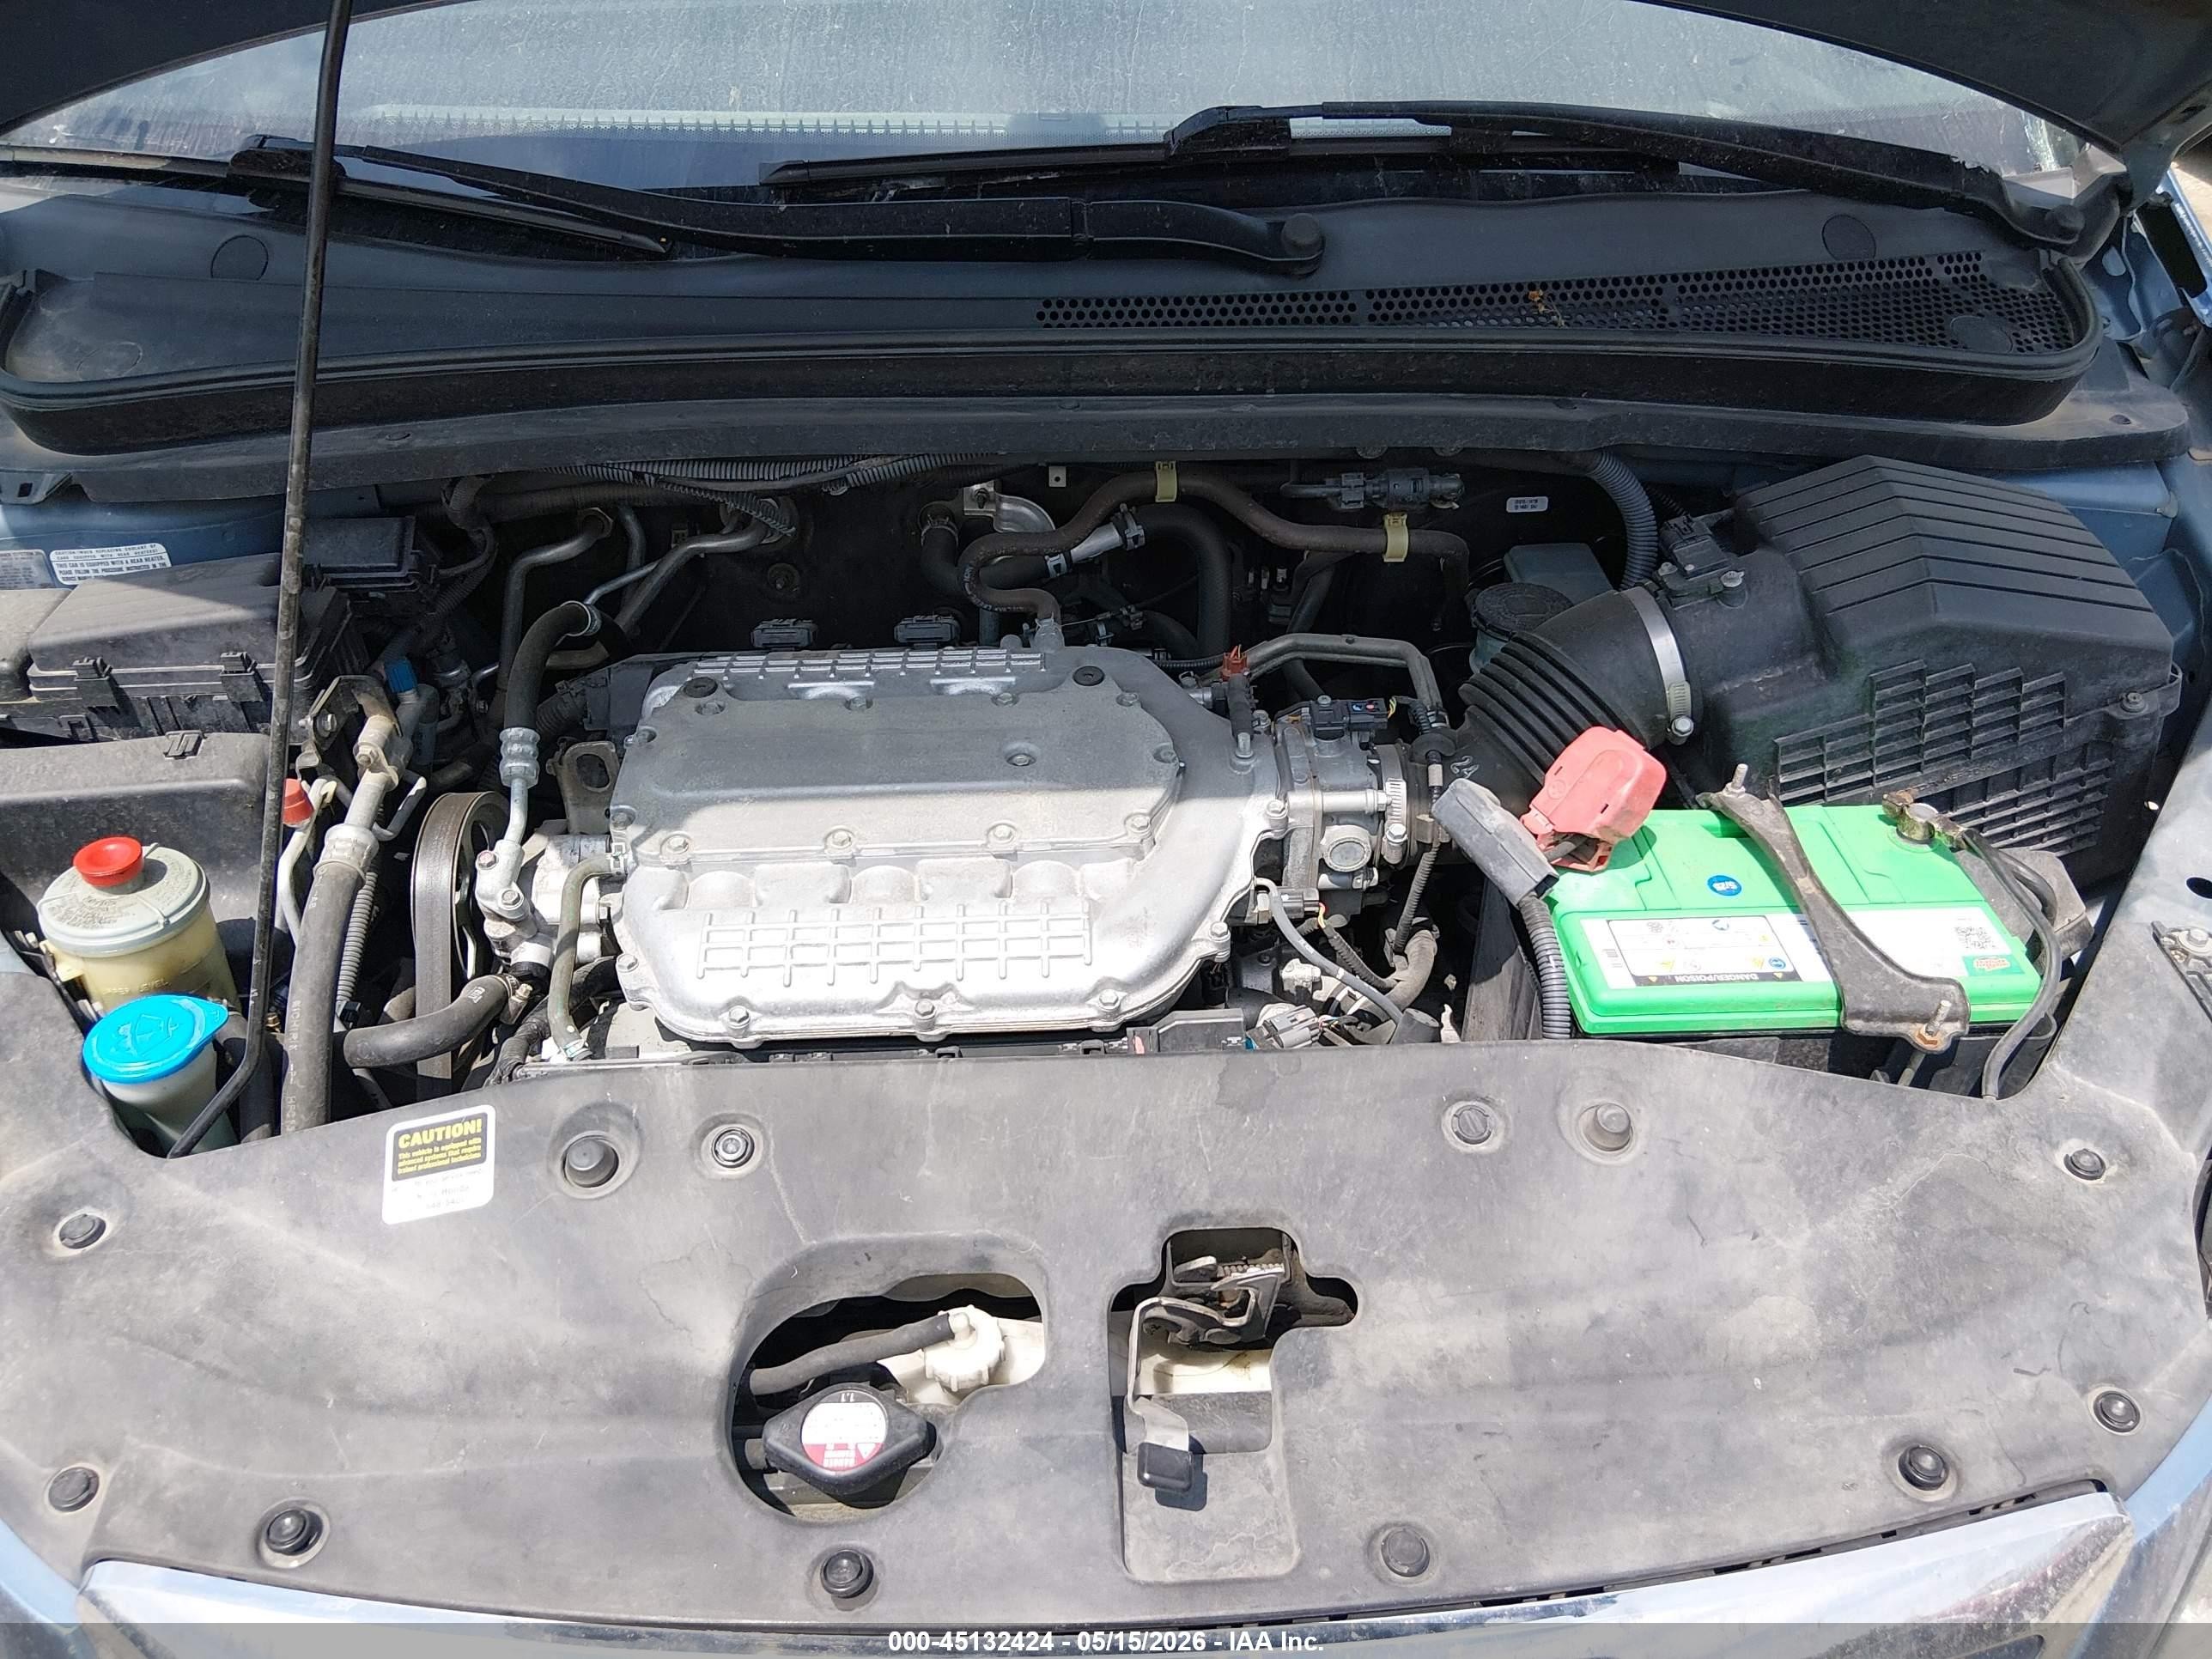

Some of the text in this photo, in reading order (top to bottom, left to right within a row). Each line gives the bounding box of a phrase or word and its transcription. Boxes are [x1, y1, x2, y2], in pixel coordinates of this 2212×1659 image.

[1674, 973, 1759, 983] DANGER/POISON
[398, 1119, 483, 1149] CAUTION!
[398, 1145, 482, 1167] advanced systems that require
[412, 1147, 433, 1158] vehicle
[441, 1139, 467, 1152] equipped
[398, 1152, 482, 1175] trained professional technicians
